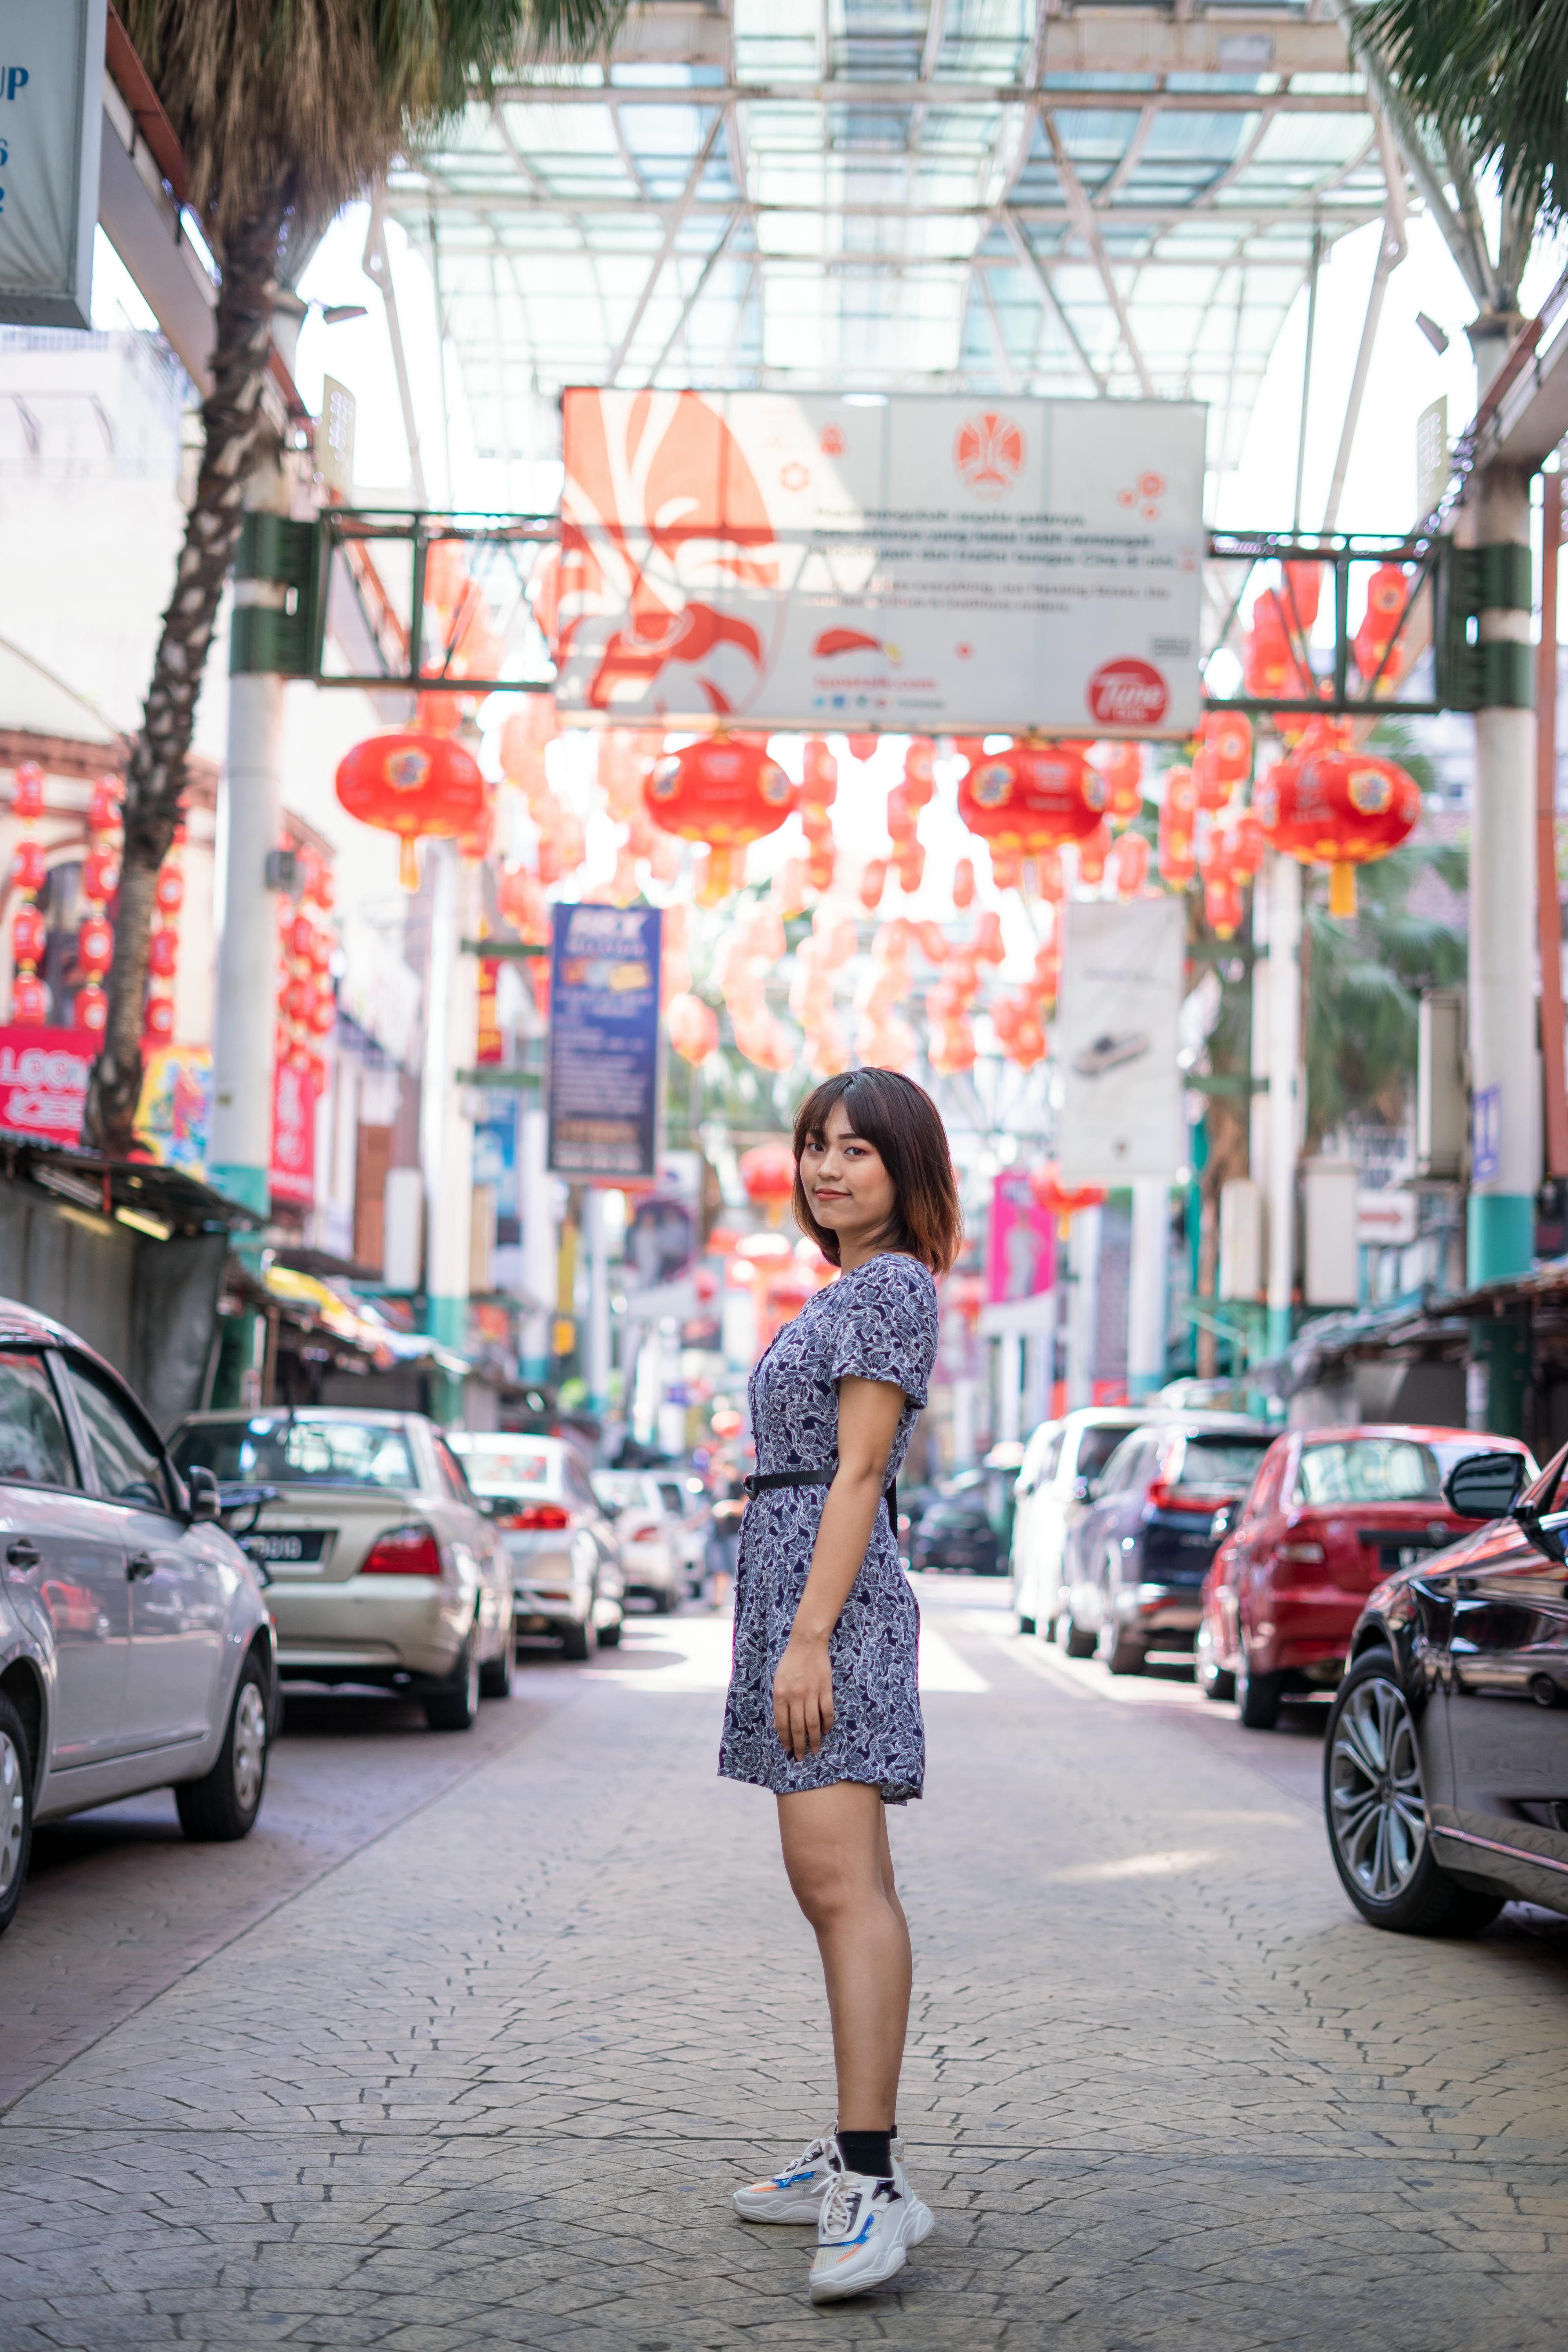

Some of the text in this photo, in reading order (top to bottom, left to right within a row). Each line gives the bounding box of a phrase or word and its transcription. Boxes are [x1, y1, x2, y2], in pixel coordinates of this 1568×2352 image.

[927, 529, 969, 544] yang
[1069, 535, 1153, 548] semangat
[919, 548, 952, 561] dan
[1094, 673, 1164, 717] Tune
